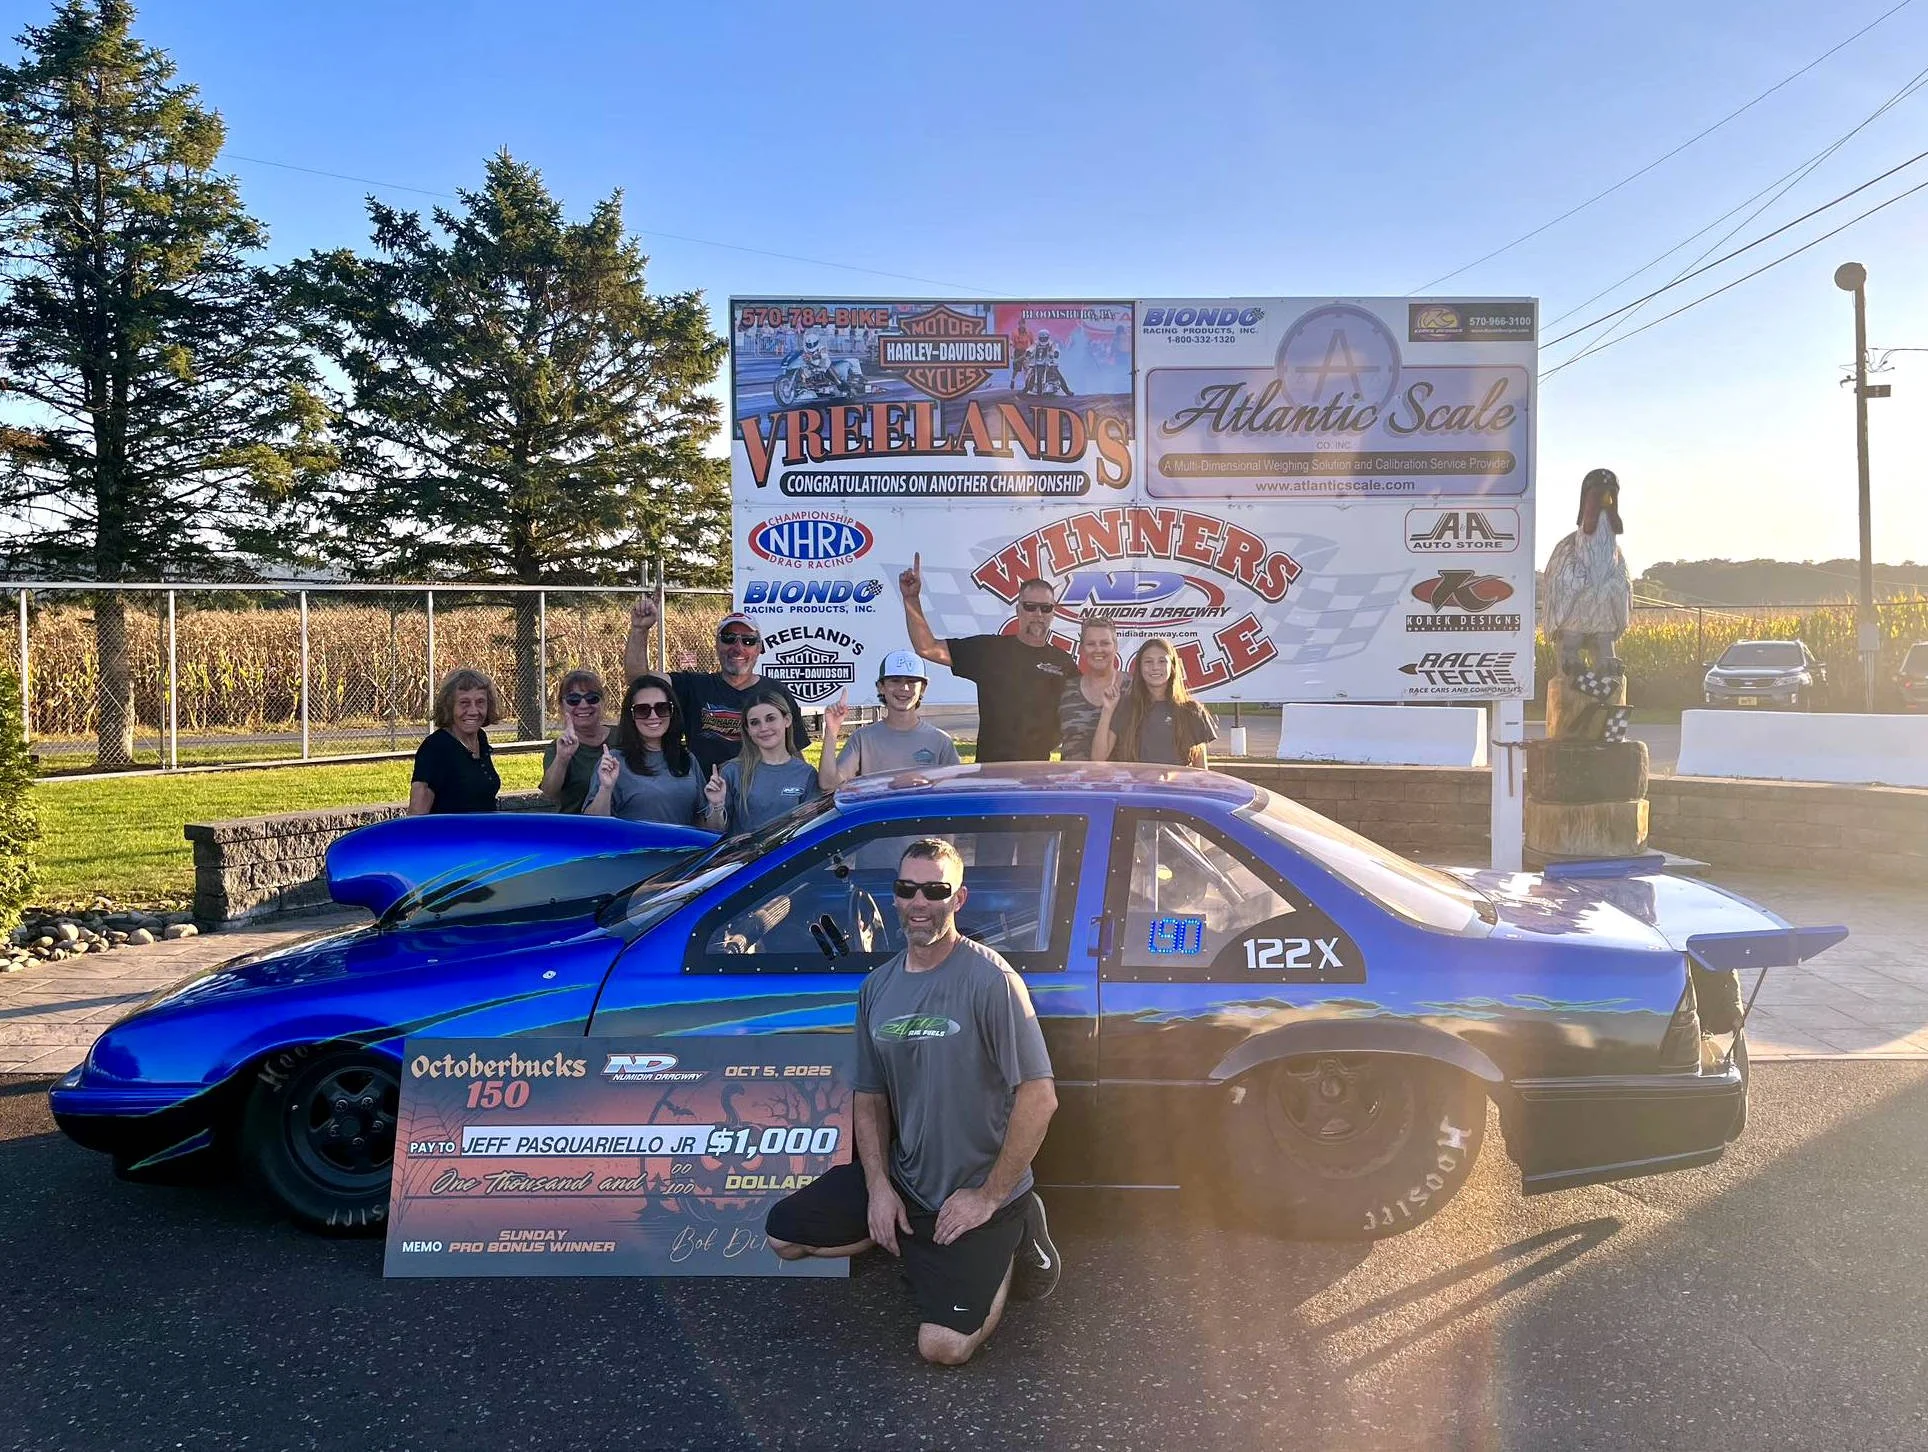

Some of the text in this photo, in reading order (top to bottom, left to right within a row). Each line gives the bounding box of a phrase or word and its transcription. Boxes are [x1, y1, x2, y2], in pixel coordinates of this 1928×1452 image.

[741, 306, 889, 328] 570-784-BIKE
[1143, 308, 1261, 326] BIONDO
[1469, 316, 1531, 327] 570-966-3100
[911, 315, 975, 336] MOTOR
[1183, 327, 1234, 335] PRODUCTS,
[1167, 335, 1236, 344] 1-800-332-1320
[886, 342, 1002, 362] HARLEY-DAVIDSON
[913, 369, 981, 392] CYCLES
[1160, 377, 1517, 434] Atlantic Scale
[738, 400, 1133, 489] VREELAND'S
[1262, 459, 1309, 473] Weighing
[1311, 458, 1350, 471] Solution
[1354, 459, 1373, 470] and
[1375, 458, 1427, 470] Calibration
[1430, 457, 1466, 469] Service
[1469, 457, 1510, 469] Provider
[787, 475, 1085, 494] CONGRATULATIONS ON ANOTHER CHAMPIONSHIP
[1255, 479, 1415, 492] www.atlanticscale.com
[768, 511, 854, 526] CHAMPIONSHIP
[770, 522, 855, 558] NHRA
[1413, 541, 1503, 549] AUTO STORE
[769, 555, 854, 569] DRAG RACING
[971, 506, 1303, 605] WINNERS
[743, 580, 879, 604] BIONDO
[744, 605, 876, 614] RACING PRODUCTS, INC.
[1079, 606, 1231, 618] NUMIDIA DRAGWAY
[1407, 615, 1520, 625] KOREK DESIGNS
[760, 626, 865, 656] REELAND'S
[785, 653, 830, 664] MOTOR
[1419, 652, 1499, 668] RACE
[767, 667, 849, 680] HARLEY-DAVIDSON
[1419, 669, 1498, 685] TECH
[787, 682, 833, 698] CYCLES
[411, 1052, 587, 1080] Octoberbucks
[724, 1065, 832, 1079] OCT 5, 2025
[466, 1081, 530, 1108] 150
[410, 1127, 839, 1158] PAY TO JEFF PASQUARIELLO JR $1,000
[430, 1169, 480, 1195] One
[484, 1170, 595, 1193] Thousand
[598, 1172, 645, 1192] and
[499, 1230, 568, 1241] SUNDAY
[670, 1225, 718, 1262] Bob
[402, 1241, 616, 1253] MEMO PRO BONUS WINNER
